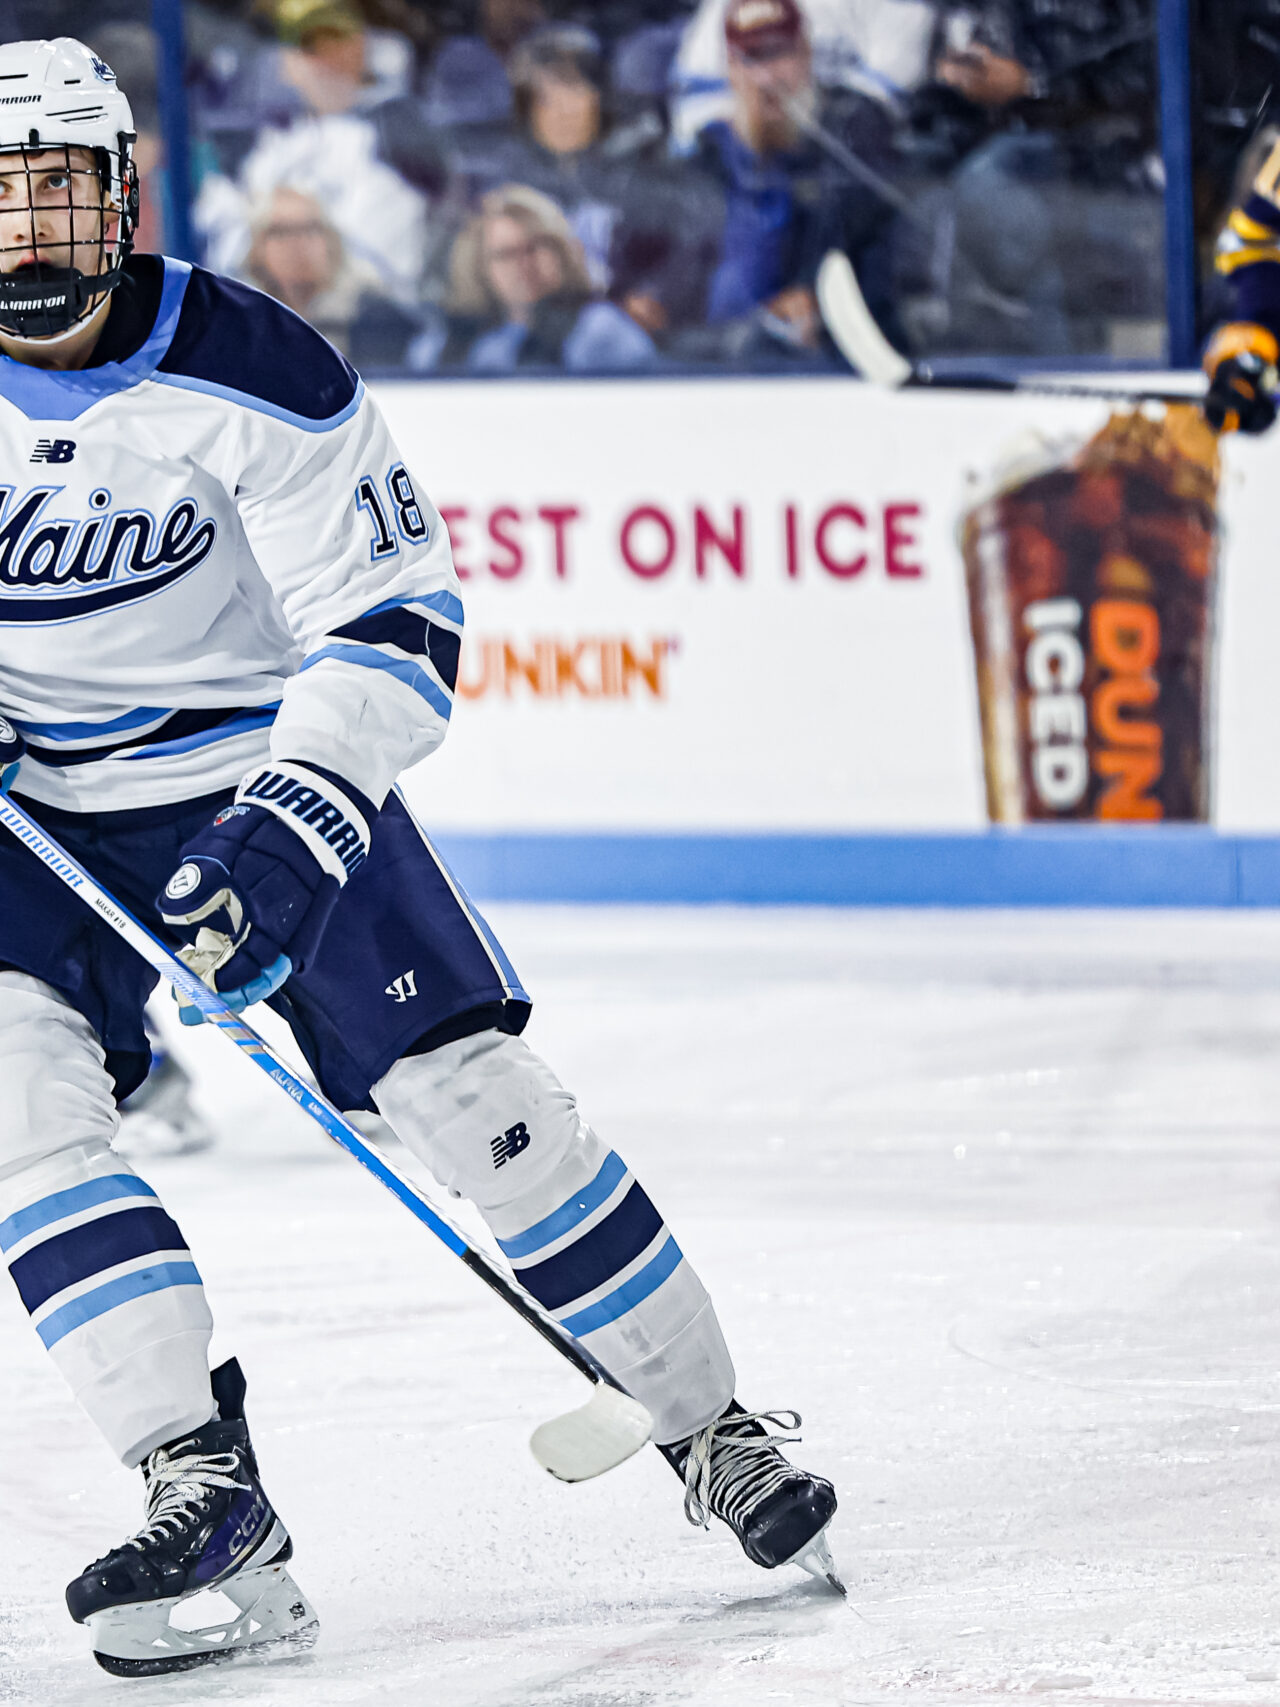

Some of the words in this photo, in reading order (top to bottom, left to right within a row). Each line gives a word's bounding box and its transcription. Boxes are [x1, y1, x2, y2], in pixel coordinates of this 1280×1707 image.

[355, 460, 430, 562] 18
[620, 504, 744, 580] ON
[784, 503, 926, 580] ICE
[1023, 600, 1087, 808] ICED
[243, 770, 367, 873] WARRI
[228, 1494, 268, 1556] CCM
